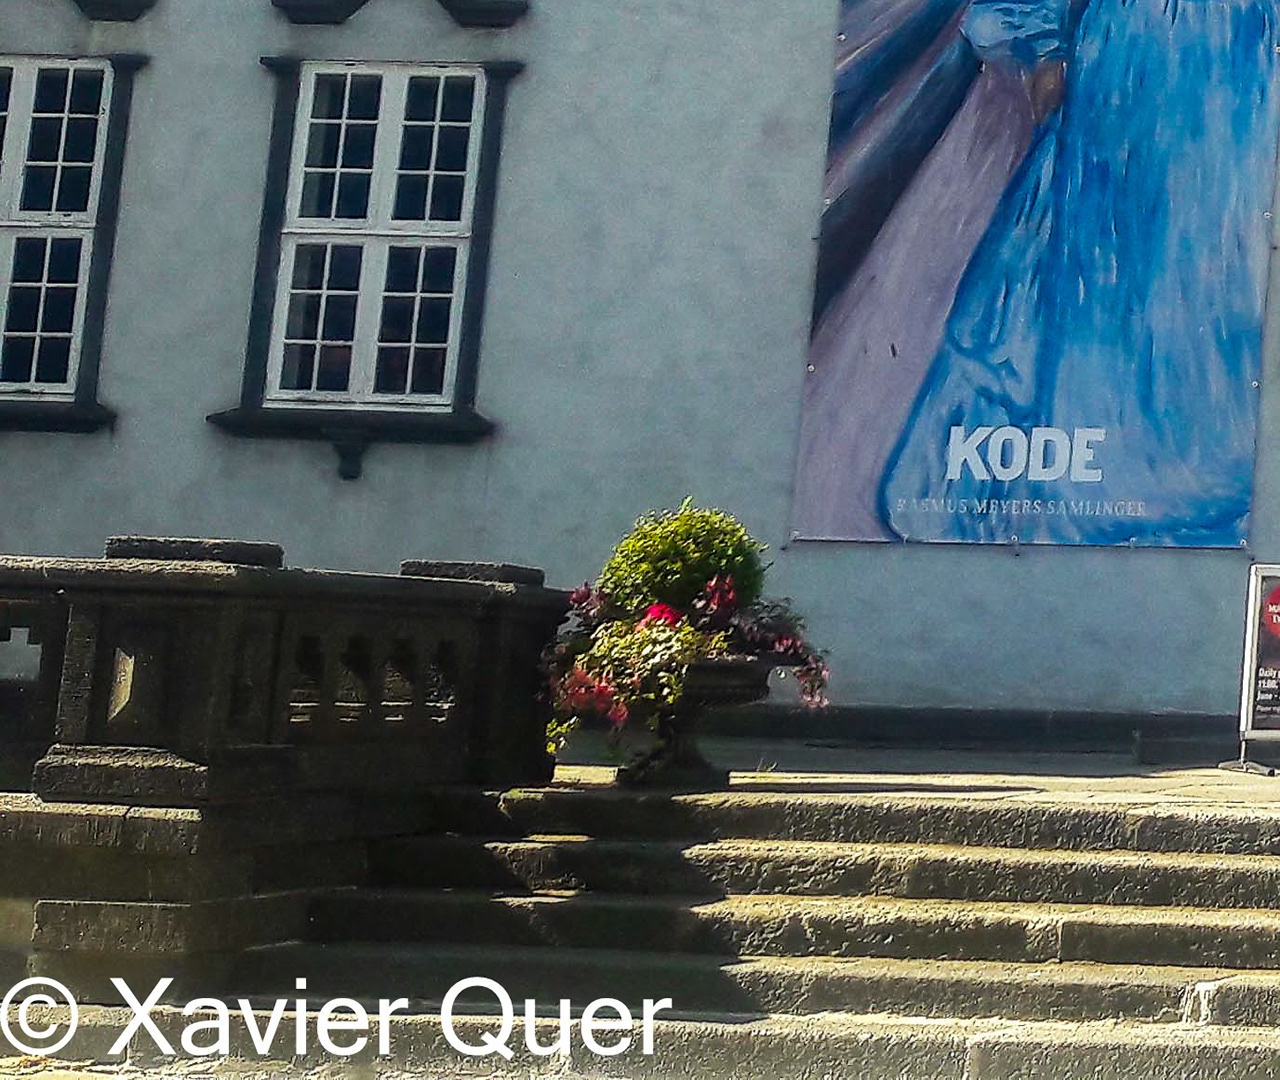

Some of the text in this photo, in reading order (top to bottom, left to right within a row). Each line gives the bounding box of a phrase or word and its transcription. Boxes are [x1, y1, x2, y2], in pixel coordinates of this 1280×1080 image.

[945, 425, 1108, 482] KODE
[897, 498, 1147, 517] RASMUS MEYERS SAMLINGER
[1257, 691, 1273, 701] June
